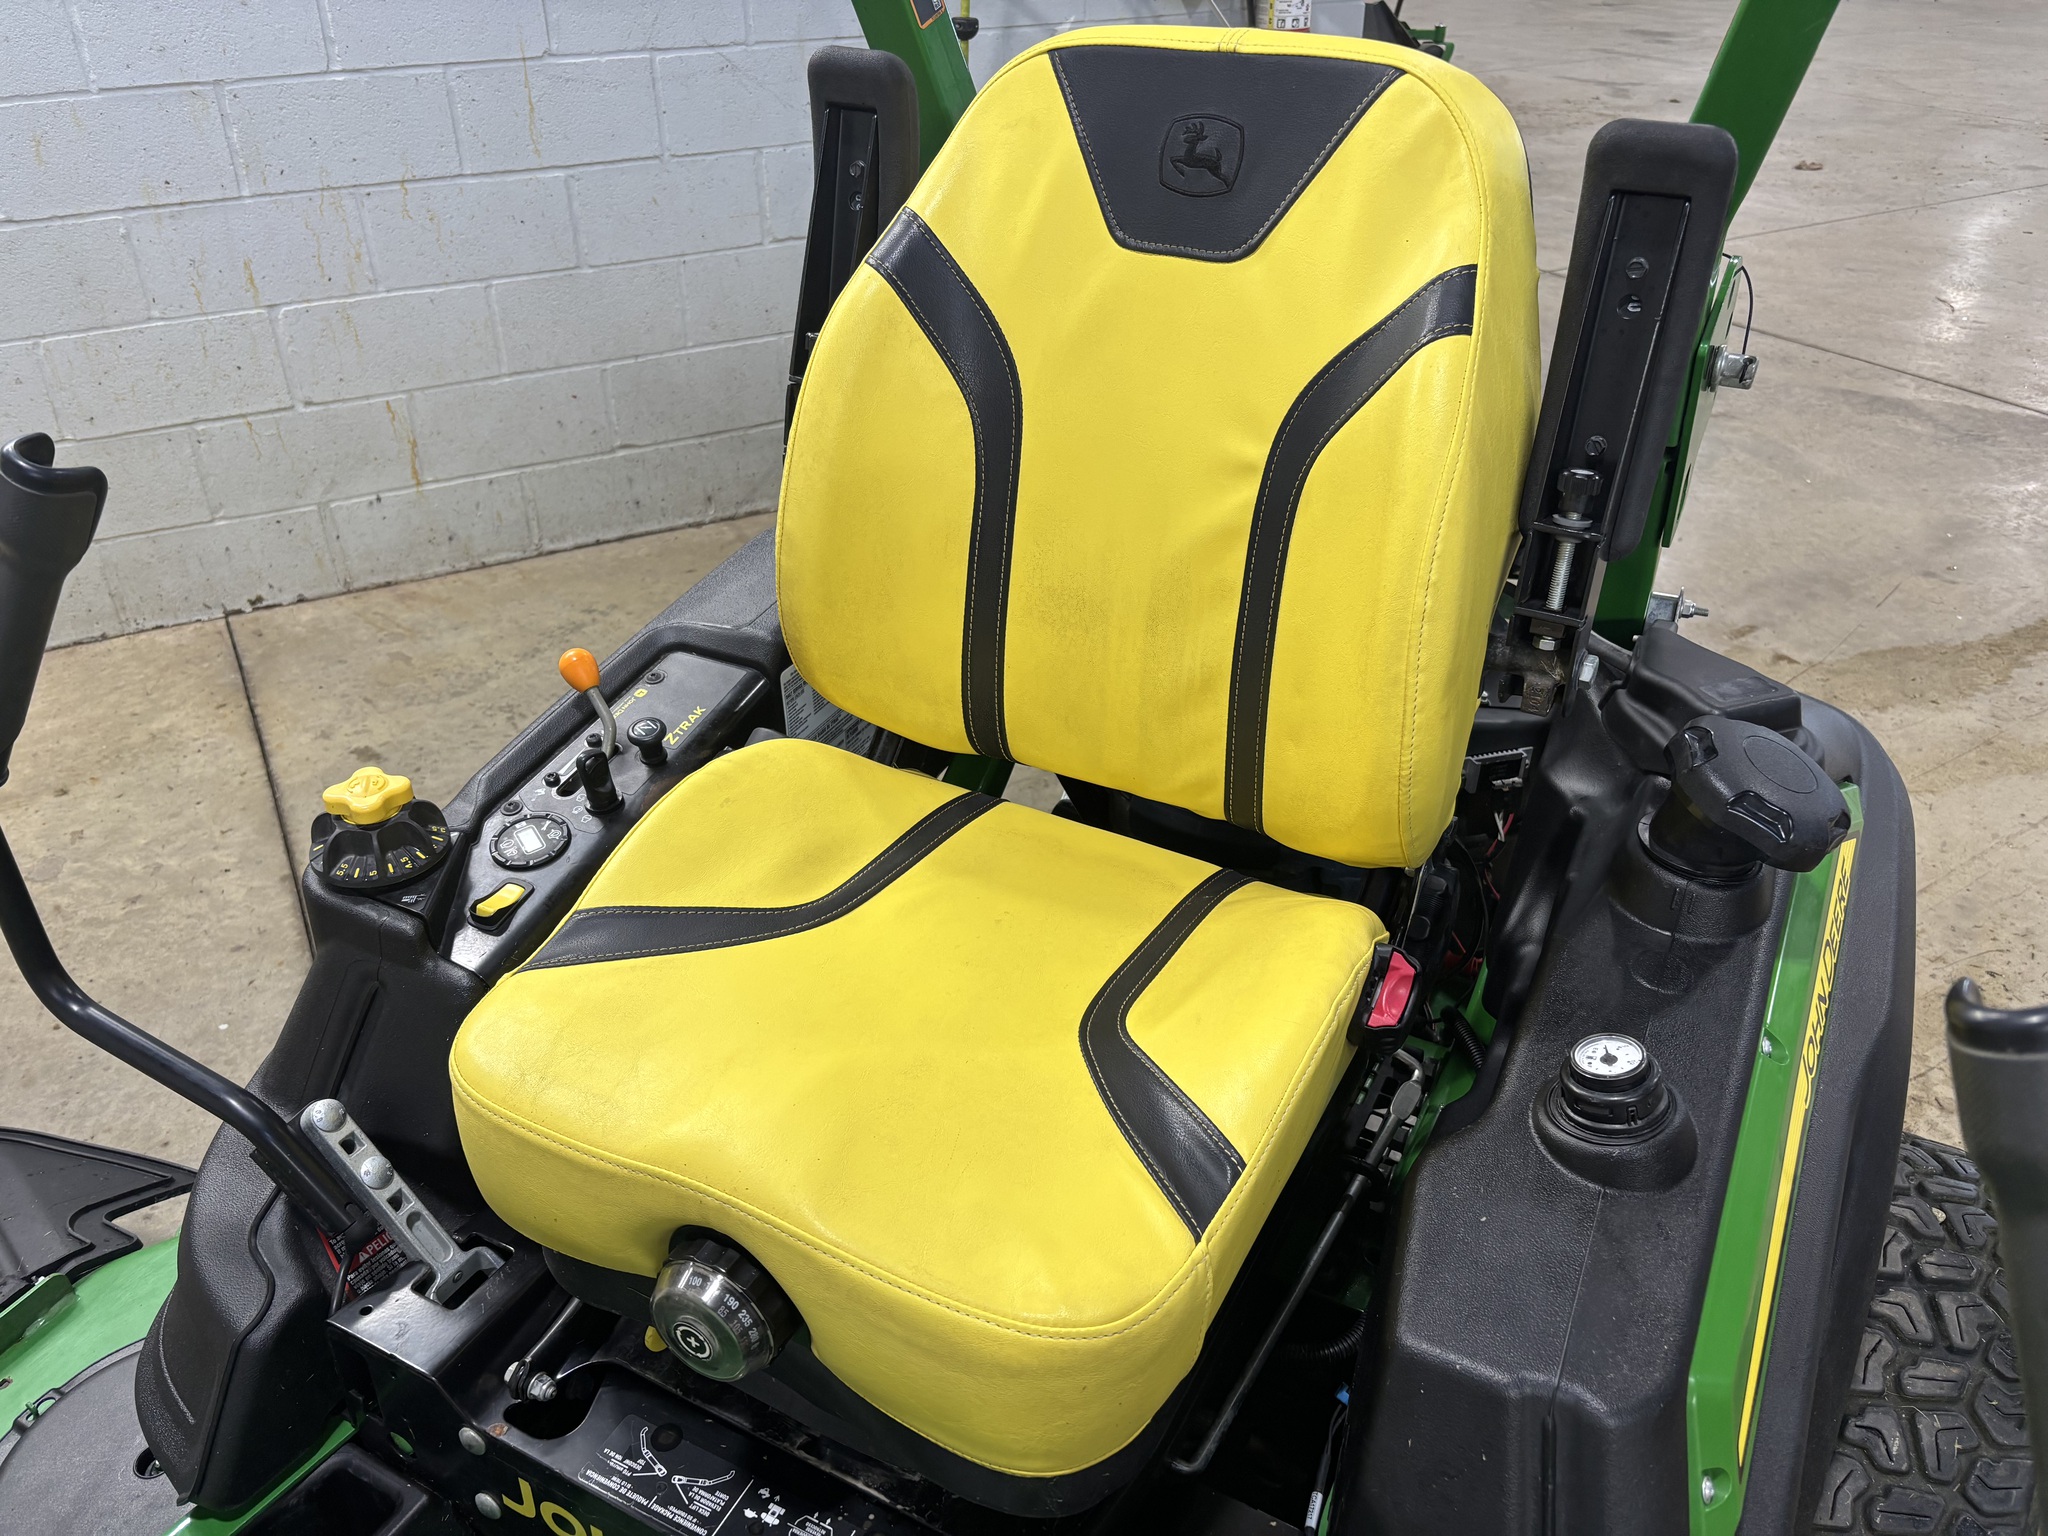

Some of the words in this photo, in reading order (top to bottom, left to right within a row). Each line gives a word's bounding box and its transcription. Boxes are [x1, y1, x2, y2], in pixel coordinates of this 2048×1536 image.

[664, 706, 706, 745] ZTRAK
[336, 863, 349, 877] 5.5
[1803, 976, 1829, 1109] JOHN
[1823, 856, 1850, 991] DEERE
[688, 1275, 703, 1287] 100
[717, 1305, 730, 1319] 85
[723, 1293, 740, 1310] 190
[738, 1309, 753, 1327] 235
[586, 1469, 620, 1490] CONVENIENCIA
[618, 1486, 627, 1494] DE
[626, 1489, 649, 1505] PAQUETE
[693, 1493, 701, 1501] DE
[698, 1489, 725, 1506] PLATAFORMA
[649, 1500, 674, 1519] PACKAGE
[689, 1503, 699, 1511] LIFT
[700, 1498, 721, 1511] ELEVADOR
[698, 1508, 710, 1517] DECK
[673, 1514, 707, 1536] CONVENIENCE
